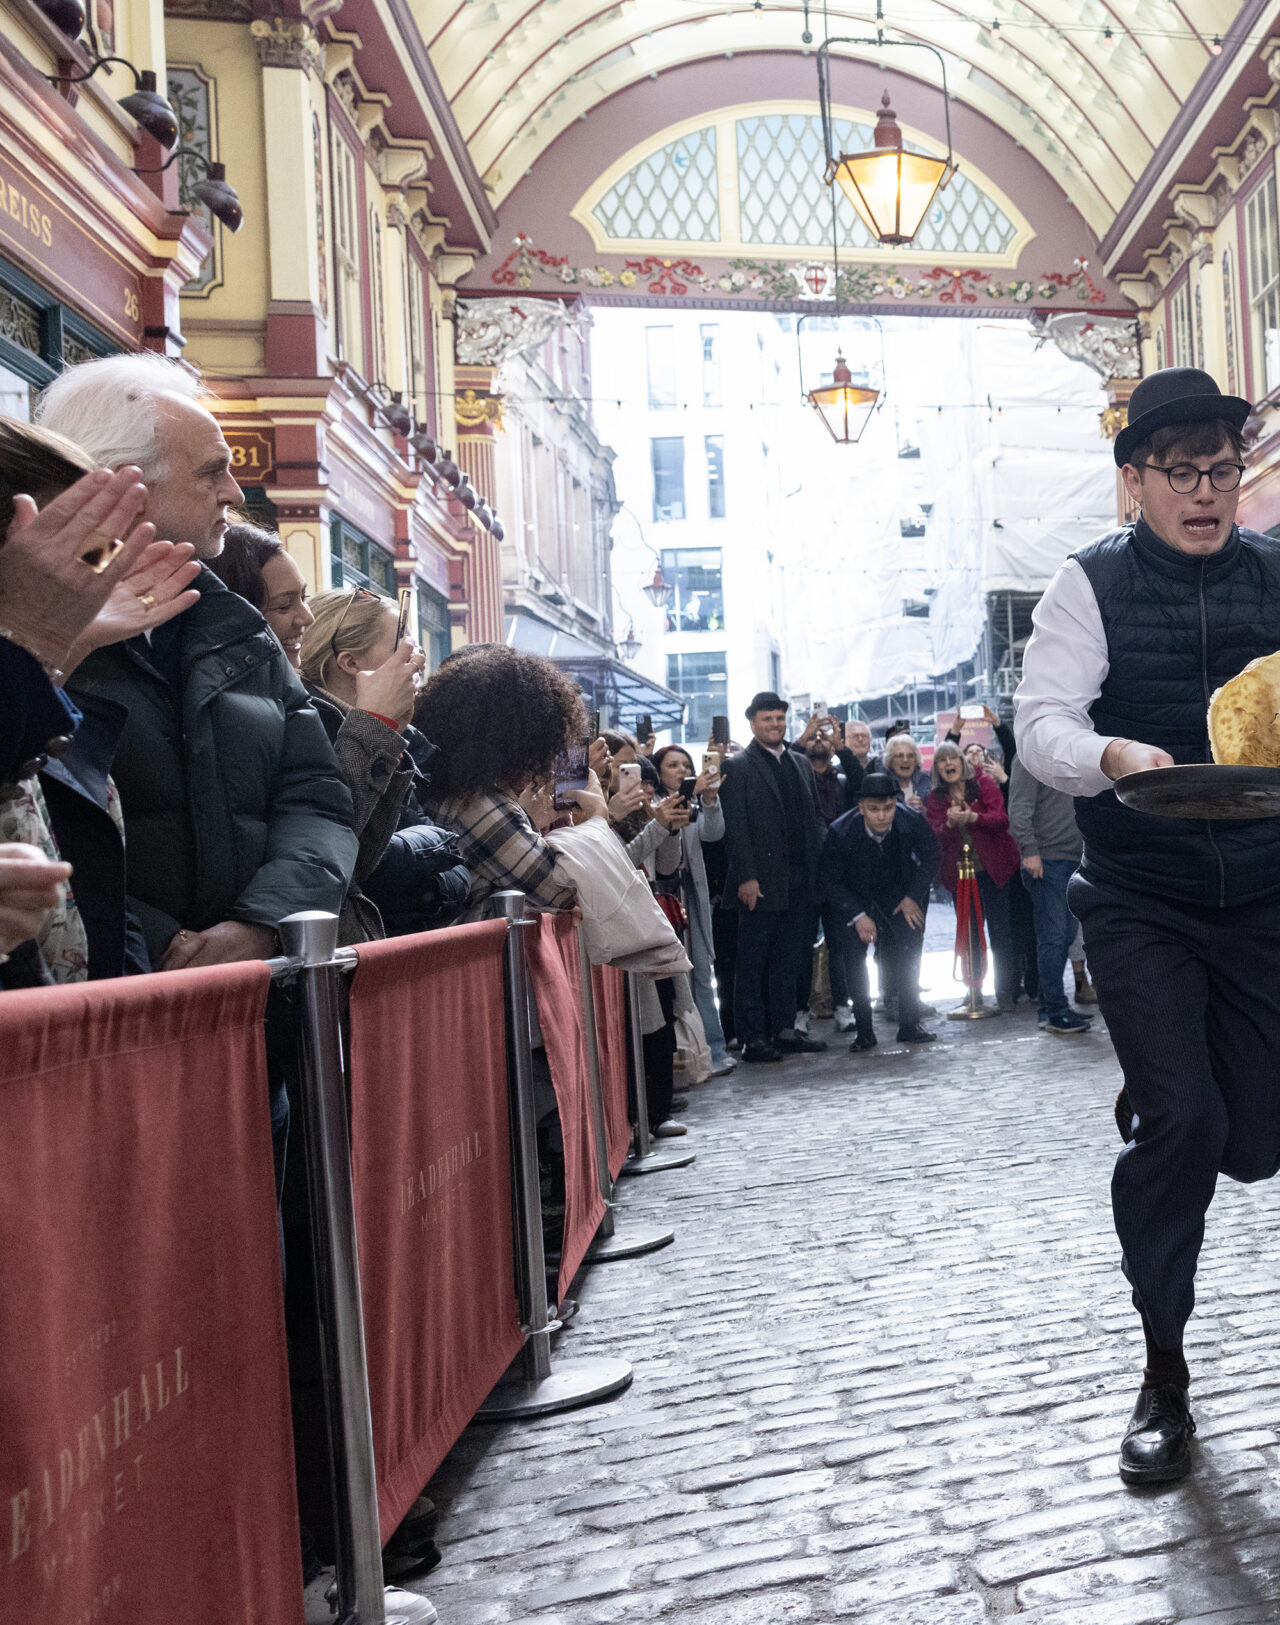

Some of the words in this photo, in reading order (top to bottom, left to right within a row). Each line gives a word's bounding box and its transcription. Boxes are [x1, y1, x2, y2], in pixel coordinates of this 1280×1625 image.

[123, 288, 139, 322] 26
[231, 446, 260, 466] 31
[9, 1347, 189, 1564] EADENHALL
